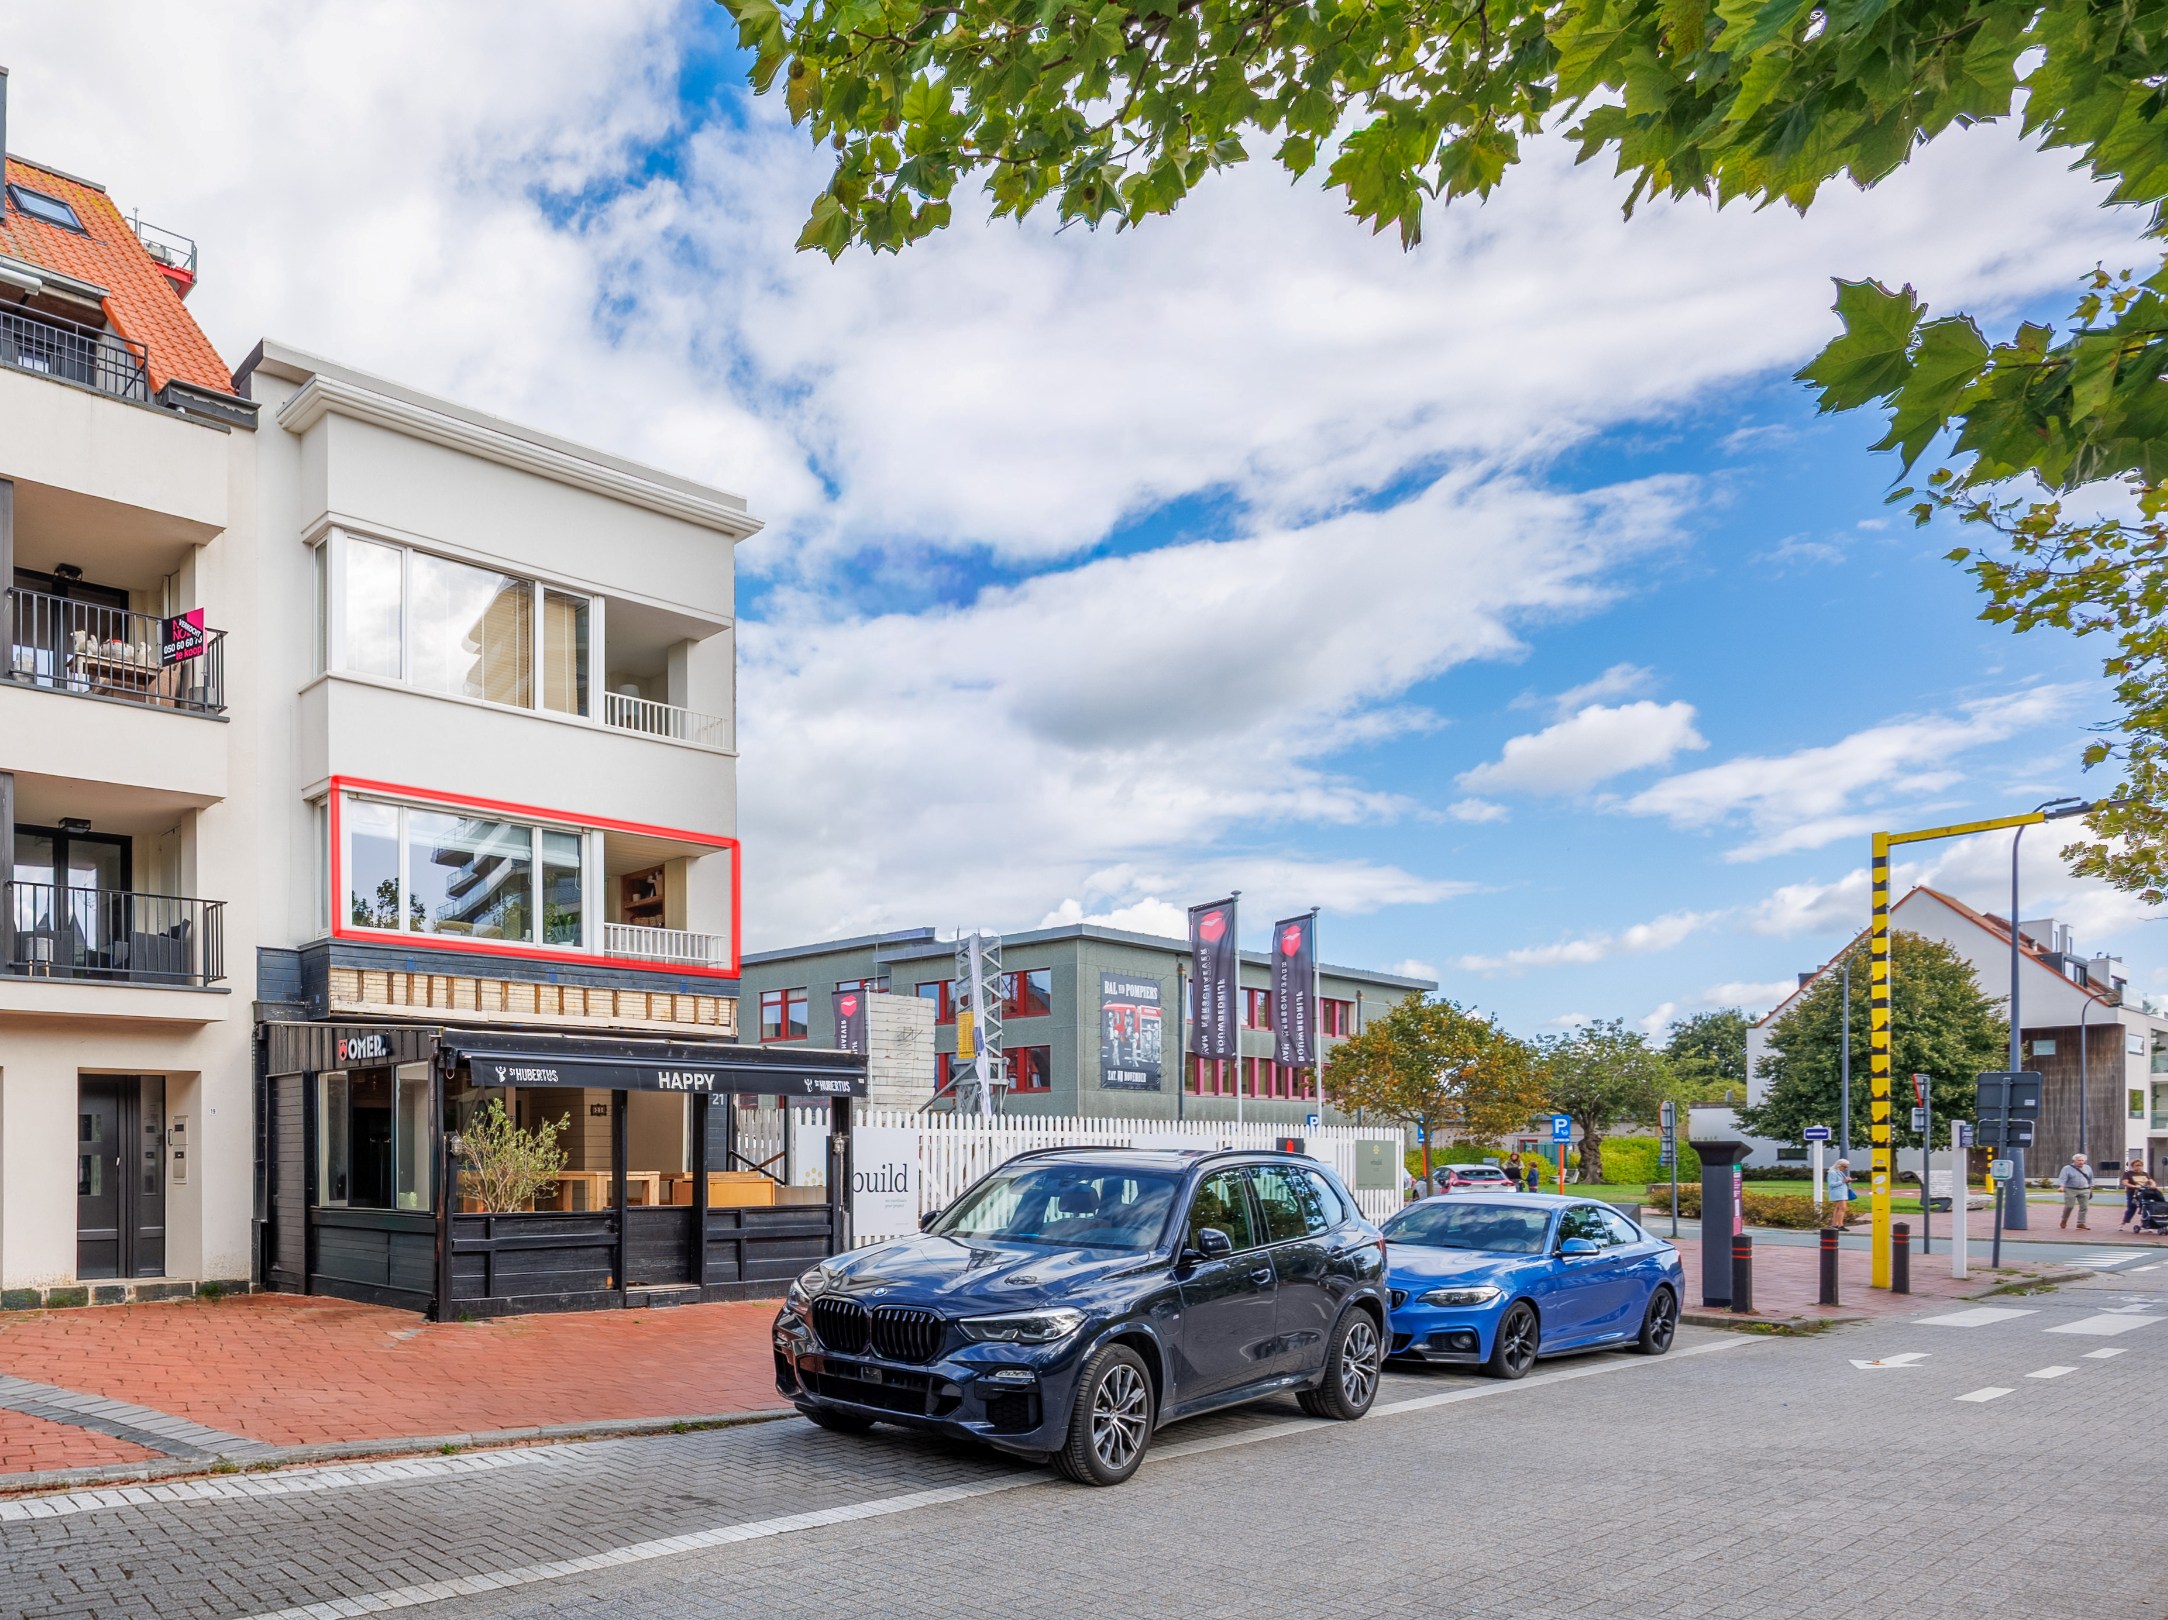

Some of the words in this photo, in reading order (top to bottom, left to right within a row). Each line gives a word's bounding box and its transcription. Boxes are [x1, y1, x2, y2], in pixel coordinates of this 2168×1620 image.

[179, 619, 201, 637] VERKOCHT
[176, 652, 183, 660] te
[184, 646, 202, 657] koop
[1104, 980, 1118, 995] BAL
[1125, 983, 1158, 1000] POMPIERS
[515, 1067, 559, 1083] HUBERTUS
[657, 1071, 716, 1091] HAPPY
[820, 1080, 851, 1093] HUBERTUS
[712, 1093, 724, 1105] 21
[1555, 1118, 1568, 1134] P
